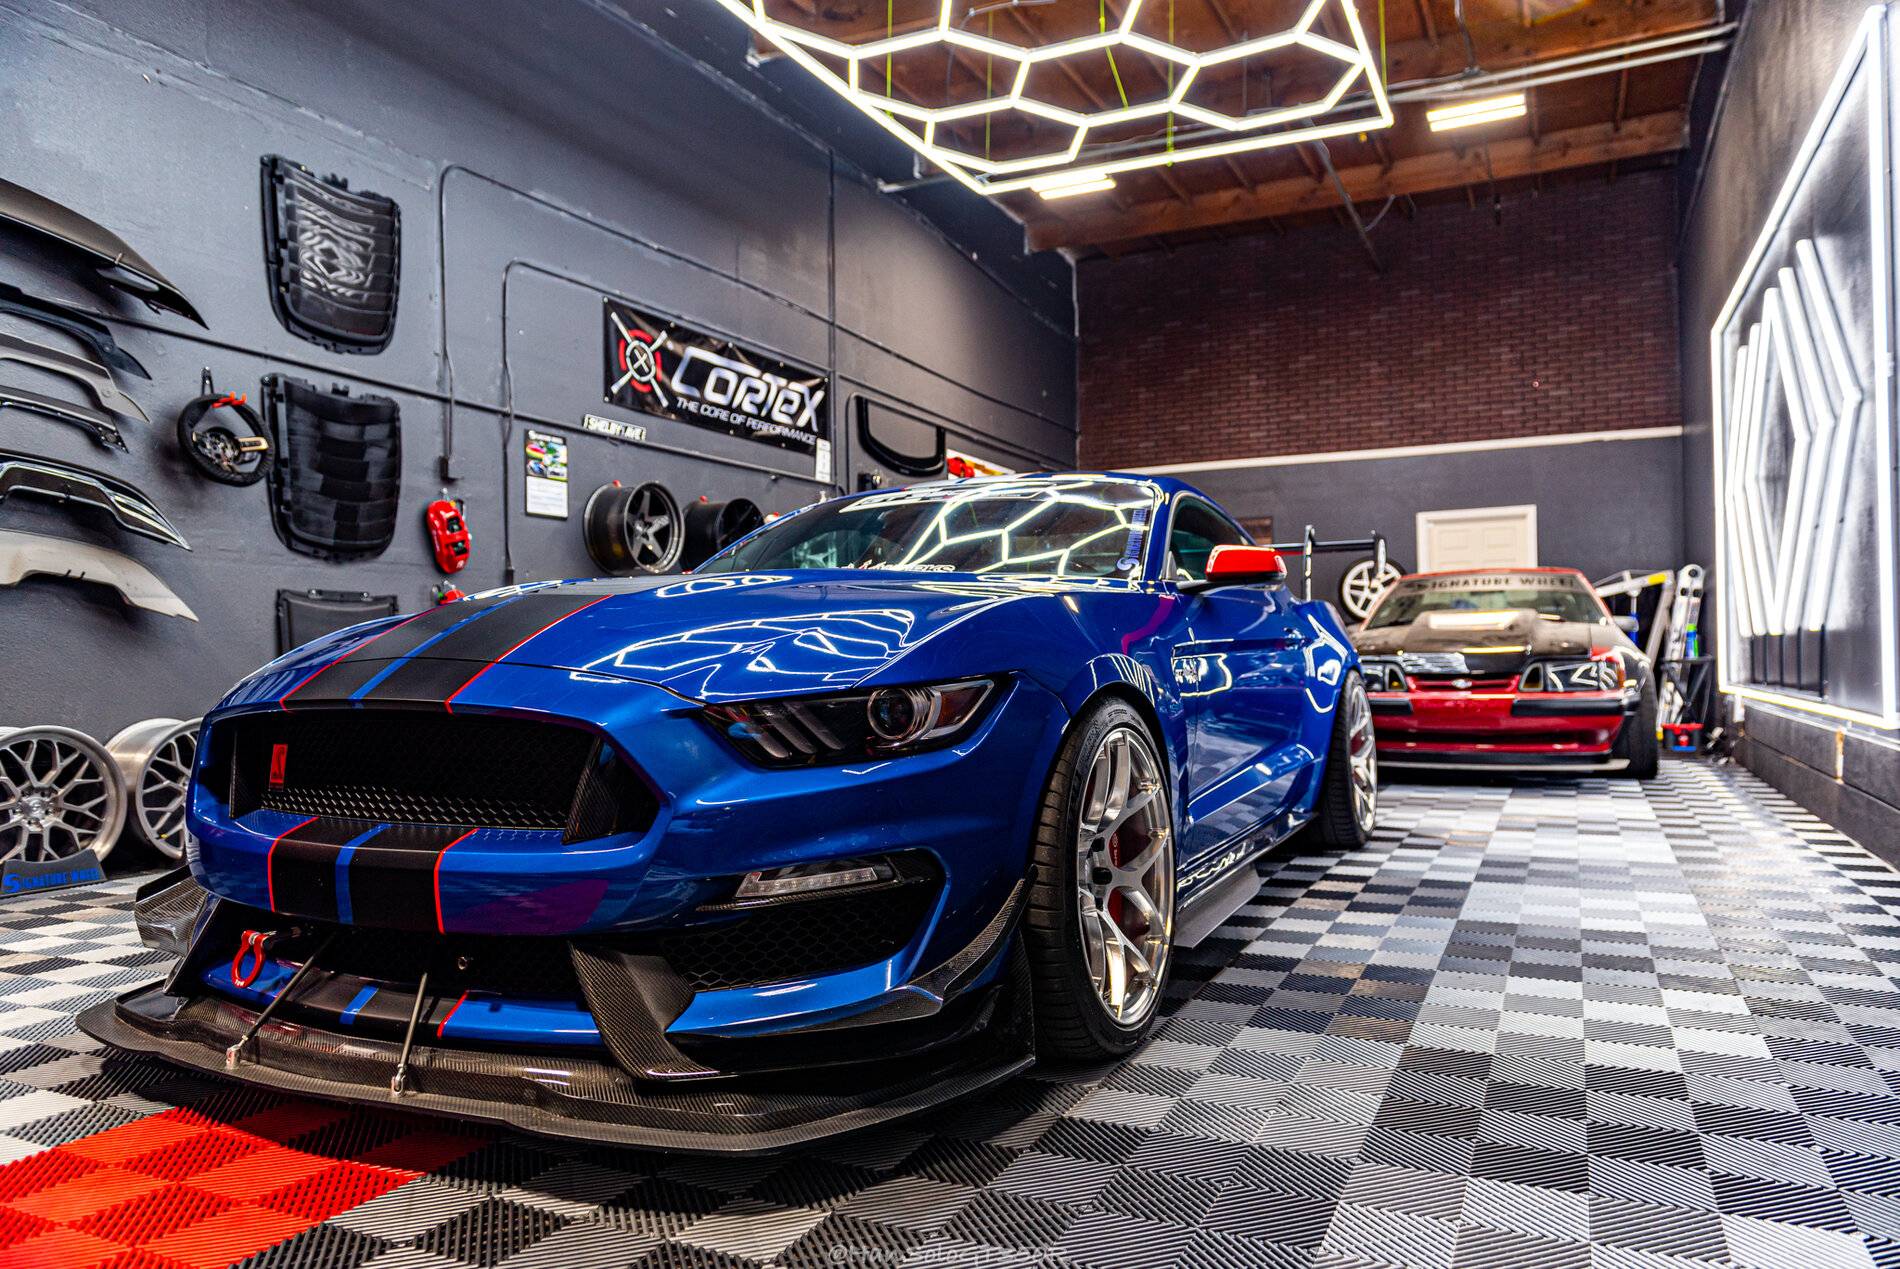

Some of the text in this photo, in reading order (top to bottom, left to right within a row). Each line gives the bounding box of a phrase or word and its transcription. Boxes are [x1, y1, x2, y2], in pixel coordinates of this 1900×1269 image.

[676, 396, 817, 445] THE CORE OF PERFORMANCE
